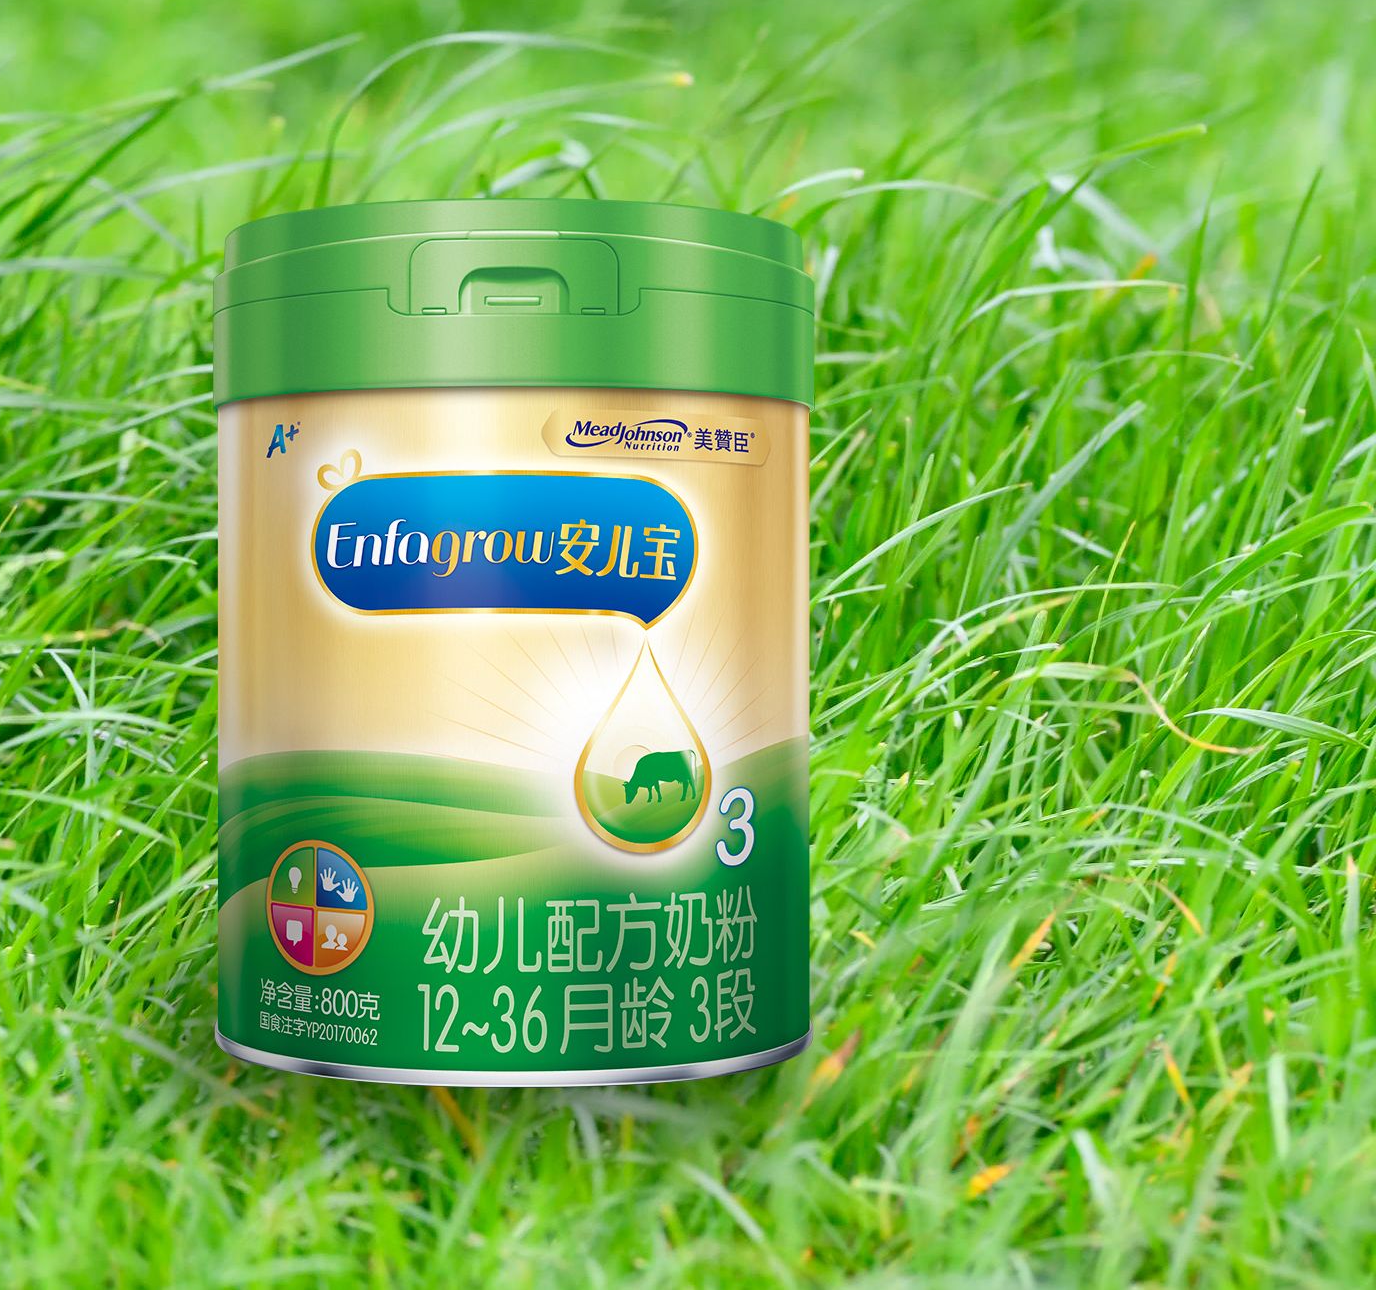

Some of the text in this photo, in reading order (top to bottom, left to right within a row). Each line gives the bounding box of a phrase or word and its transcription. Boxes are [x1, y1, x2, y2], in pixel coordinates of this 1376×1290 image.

[623, 441, 680, 452] Nutrition
[715, 786, 755, 867] 3
[421, 884, 757, 975] 幼儿配方奶粉
[259, 1010, 379, 1046] 国食注字YP20170062
